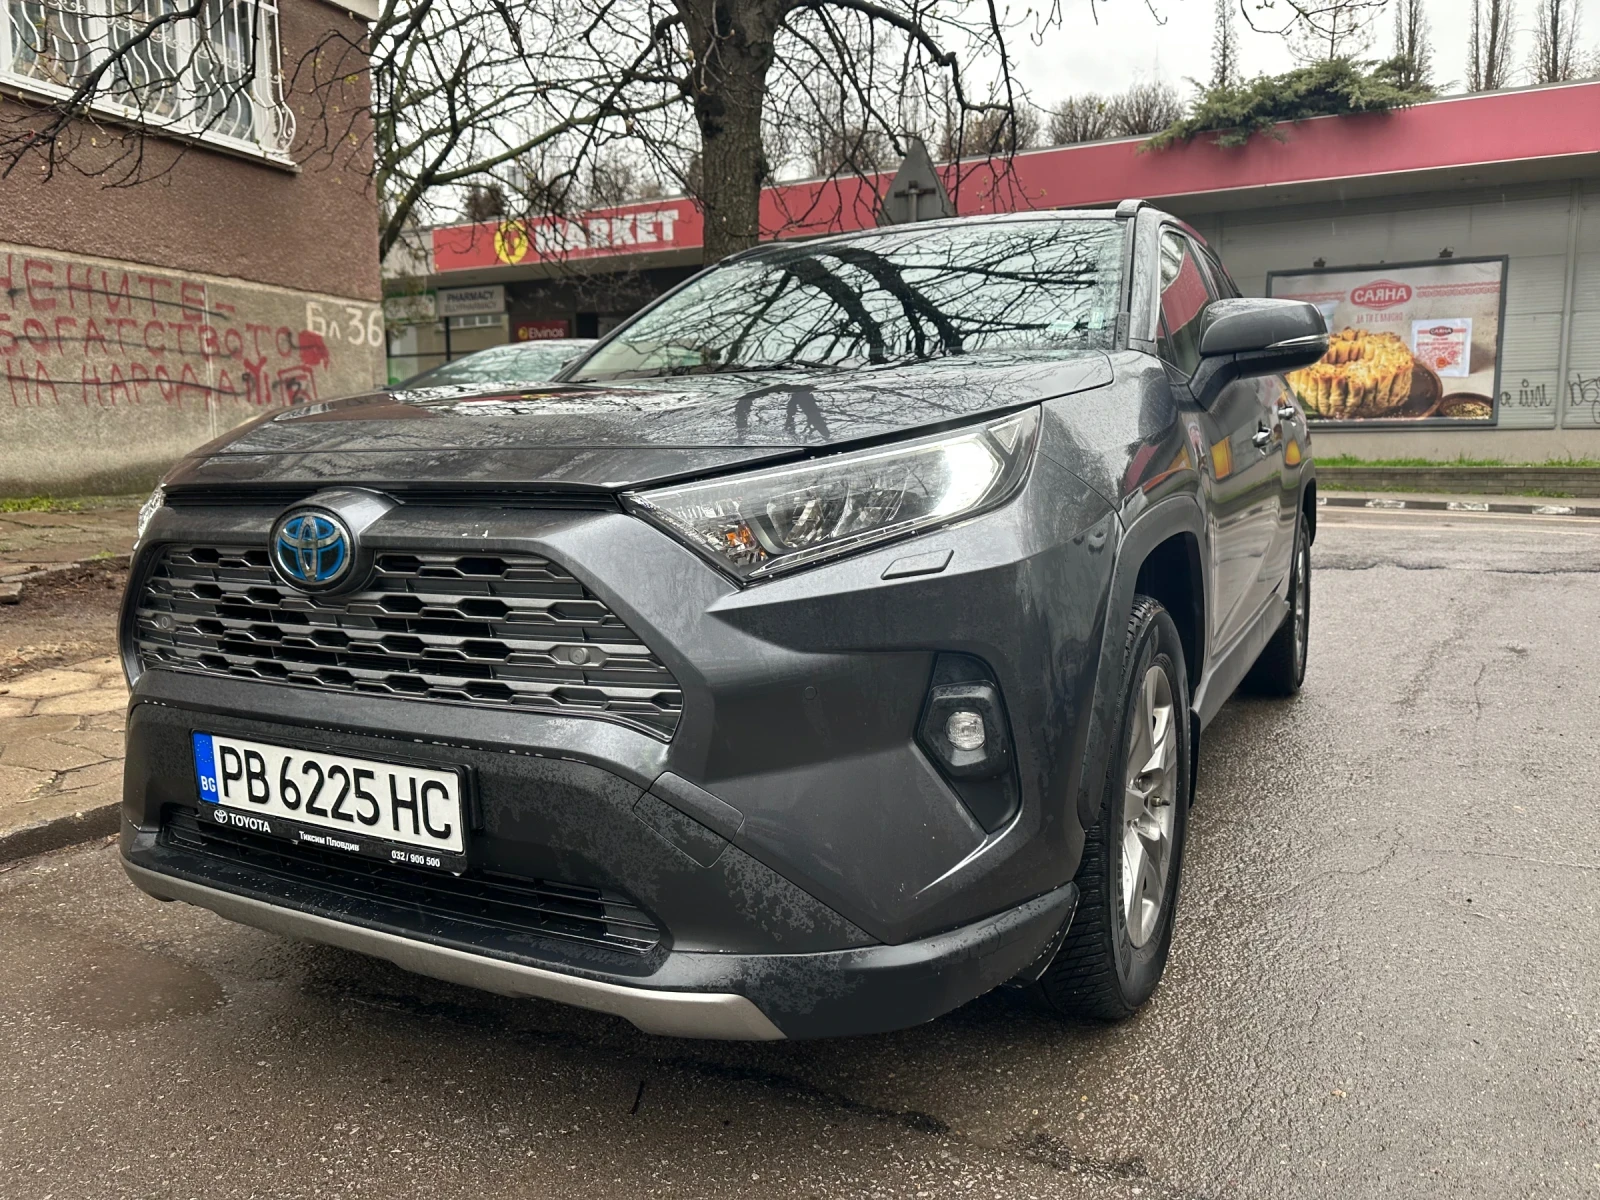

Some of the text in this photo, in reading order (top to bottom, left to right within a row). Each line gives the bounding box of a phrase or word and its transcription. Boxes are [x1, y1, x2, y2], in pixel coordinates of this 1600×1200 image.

[535, 209, 679, 253] MARKET
[447, 290, 494, 303] PHARMACY
[1354, 287, 1407, 303] САЯНА
[306, 301, 340, 340] Бл
[348, 304, 383, 347] 36
[529, 327, 565, 339] Elvinos
[7, 359, 59, 407] НА
[201, 775, 216, 793] BG
[219, 745, 451, 840] PB 6225 HC
[229, 812, 271, 833] TOYOTA
[299, 830, 360, 852] Тиксим Пловдив
[391, 850, 405, 862] 032
[410, 854, 424, 866] 900
[426, 857, 440, 868] 500
